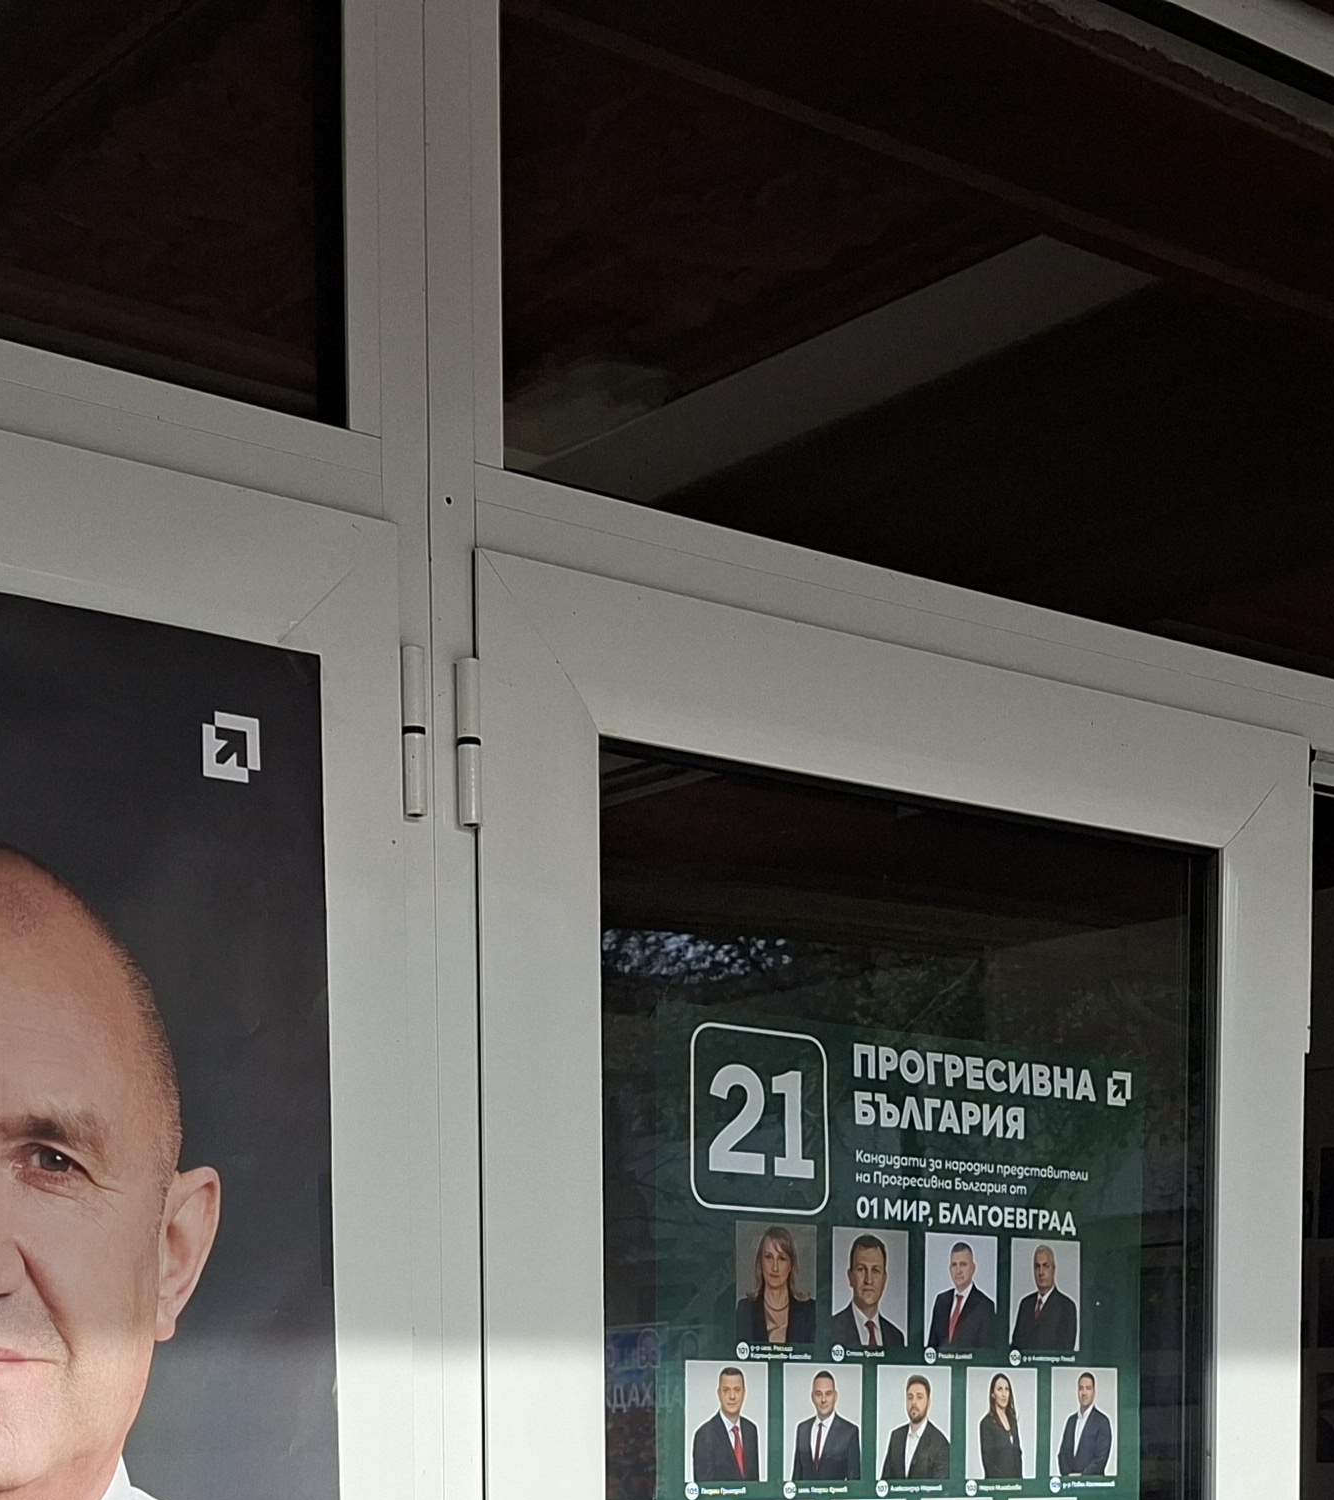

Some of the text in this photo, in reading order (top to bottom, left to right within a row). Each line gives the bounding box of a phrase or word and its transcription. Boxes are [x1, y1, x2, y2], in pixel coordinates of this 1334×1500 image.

[853, 1043, 1097, 1102] ПРОГРЕСИВНА
[709, 1064, 815, 1179] 21
[854, 1091, 1025, 1140] БЪЛГАРИЯ
[855, 1149, 1089, 1181] Кандидати за народни представители
[855, 1171, 1027, 1196] на Прогресивна България от
[856, 1196, 1077, 1236] 01 МИР, БЛАГОЕВГРАД
